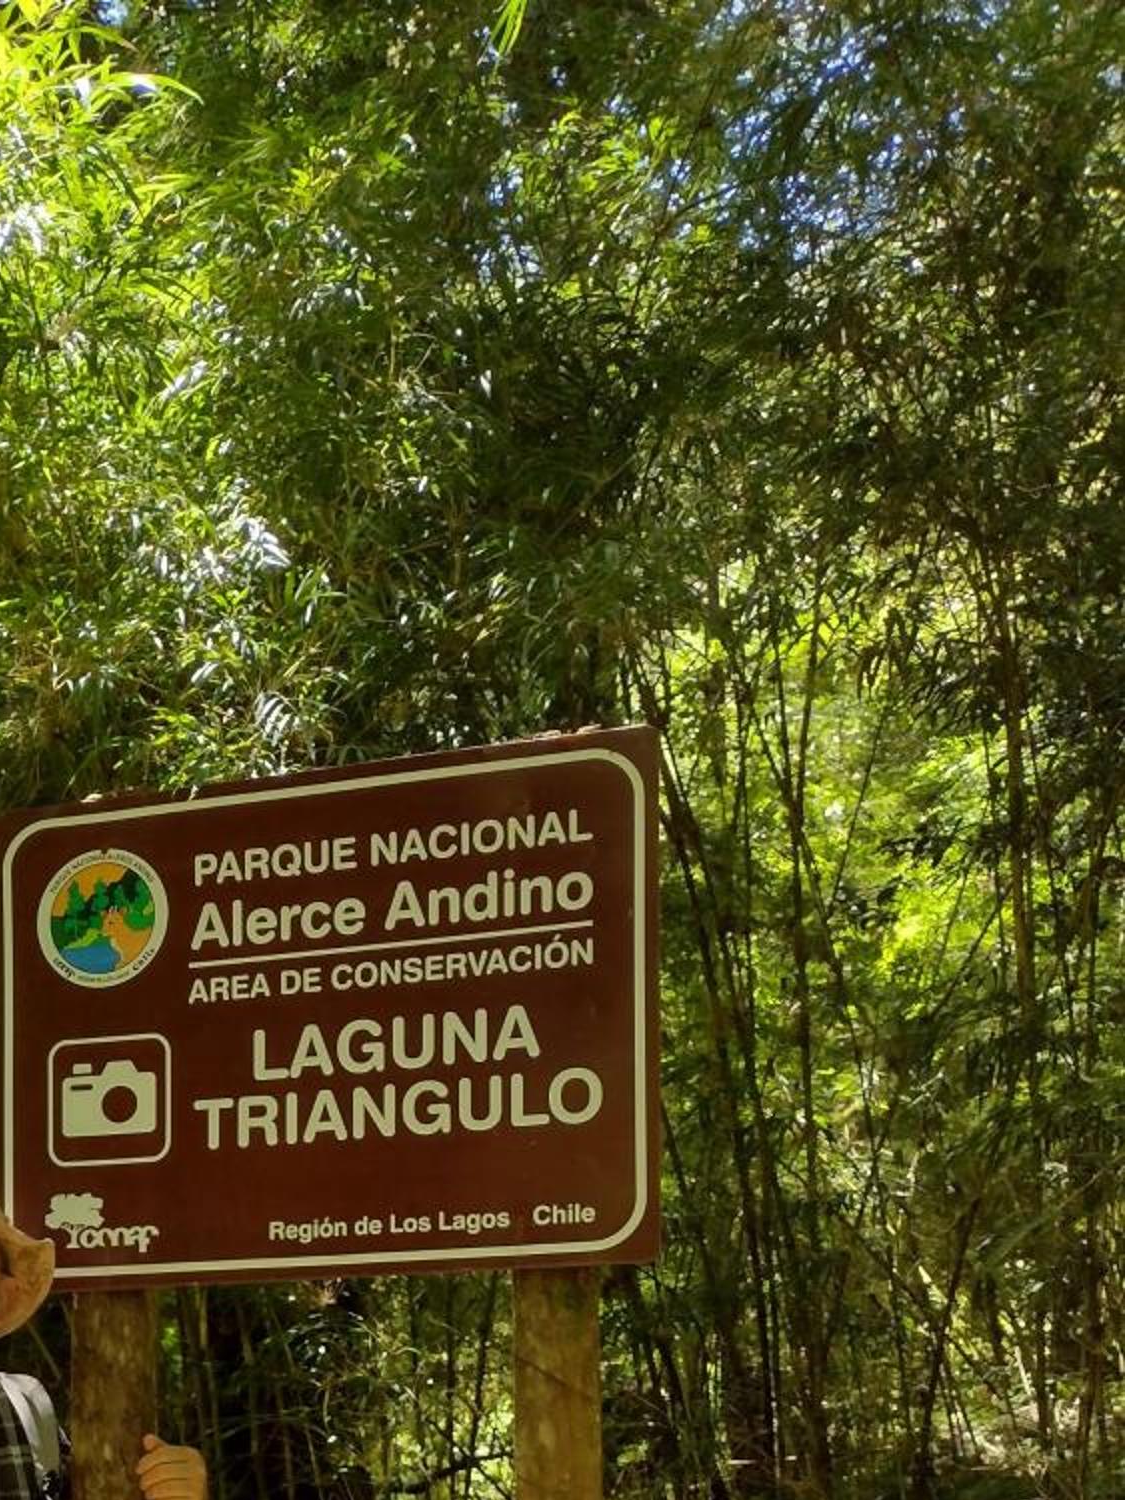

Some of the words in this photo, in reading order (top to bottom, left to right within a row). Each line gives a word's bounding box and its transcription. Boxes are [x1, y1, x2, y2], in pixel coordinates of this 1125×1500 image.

[194, 836, 358, 887] PARQUE
[370, 809, 594, 867] NACIONAL
[190, 898, 366, 951] Alerce
[384, 869, 594, 931] Andino
[188, 972, 272, 1005] AREA
[280, 967, 323, 996] DE
[330, 934, 594, 990] CONSERVACIÓN
[252, 1004, 542, 1083] LAGUNA
[192, 1067, 604, 1150] TRIANGULO
[268, 1216, 348, 1244] Región
[354, 1215, 384, 1236] de
[389, 1213, 432, 1234] Los
[438, 1210, 511, 1235] Lagos
[532, 1202, 596, 1226] Chile
